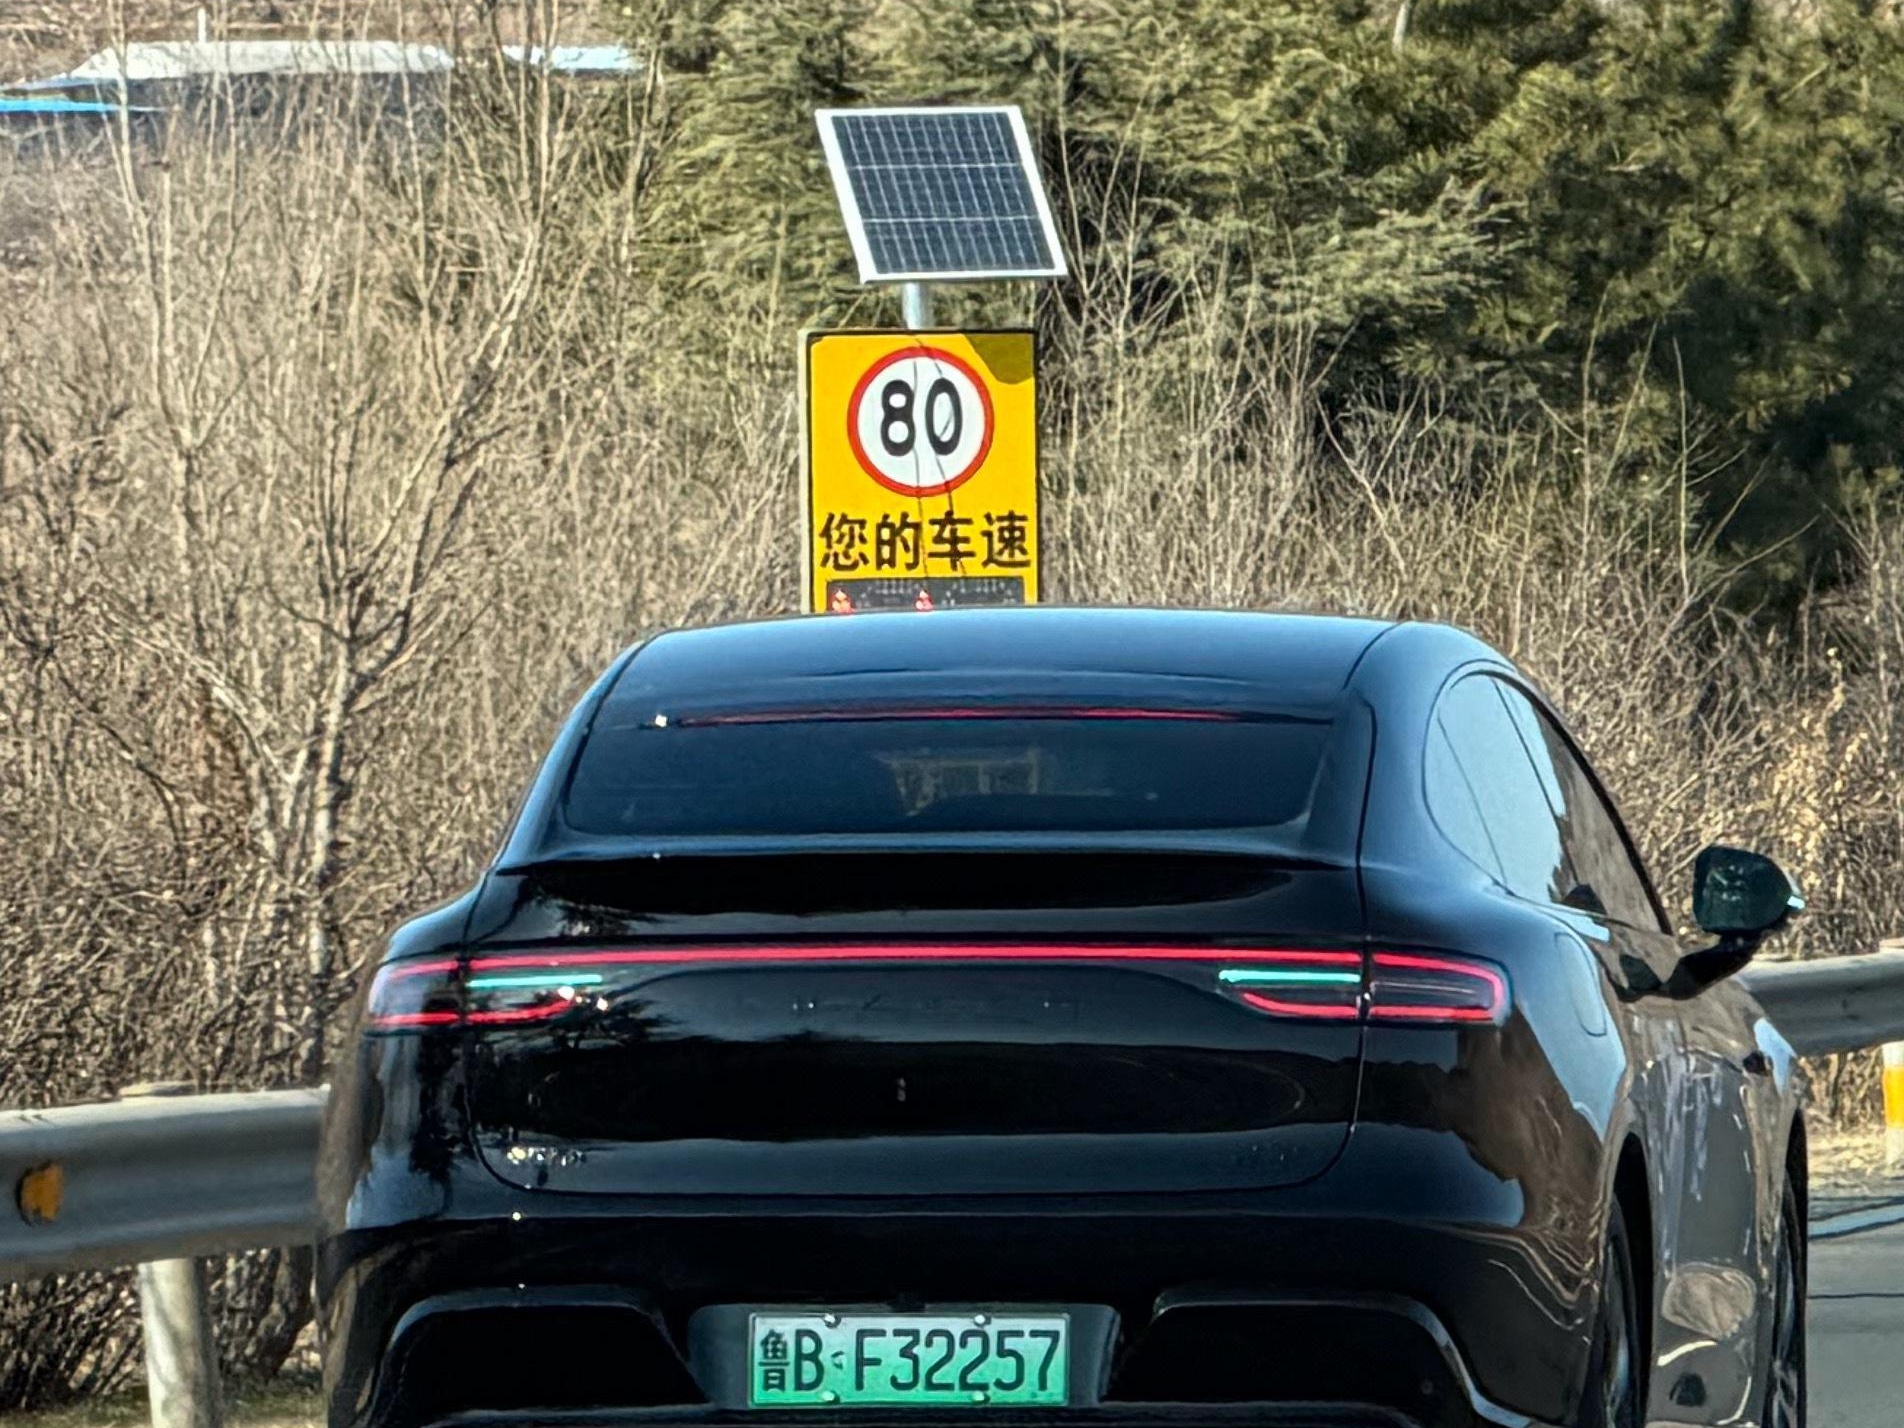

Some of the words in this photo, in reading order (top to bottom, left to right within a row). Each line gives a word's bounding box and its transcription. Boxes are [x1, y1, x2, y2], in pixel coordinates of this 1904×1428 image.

[881, 379, 963, 457] 80
[819, 510, 1031, 572] 您的车速
